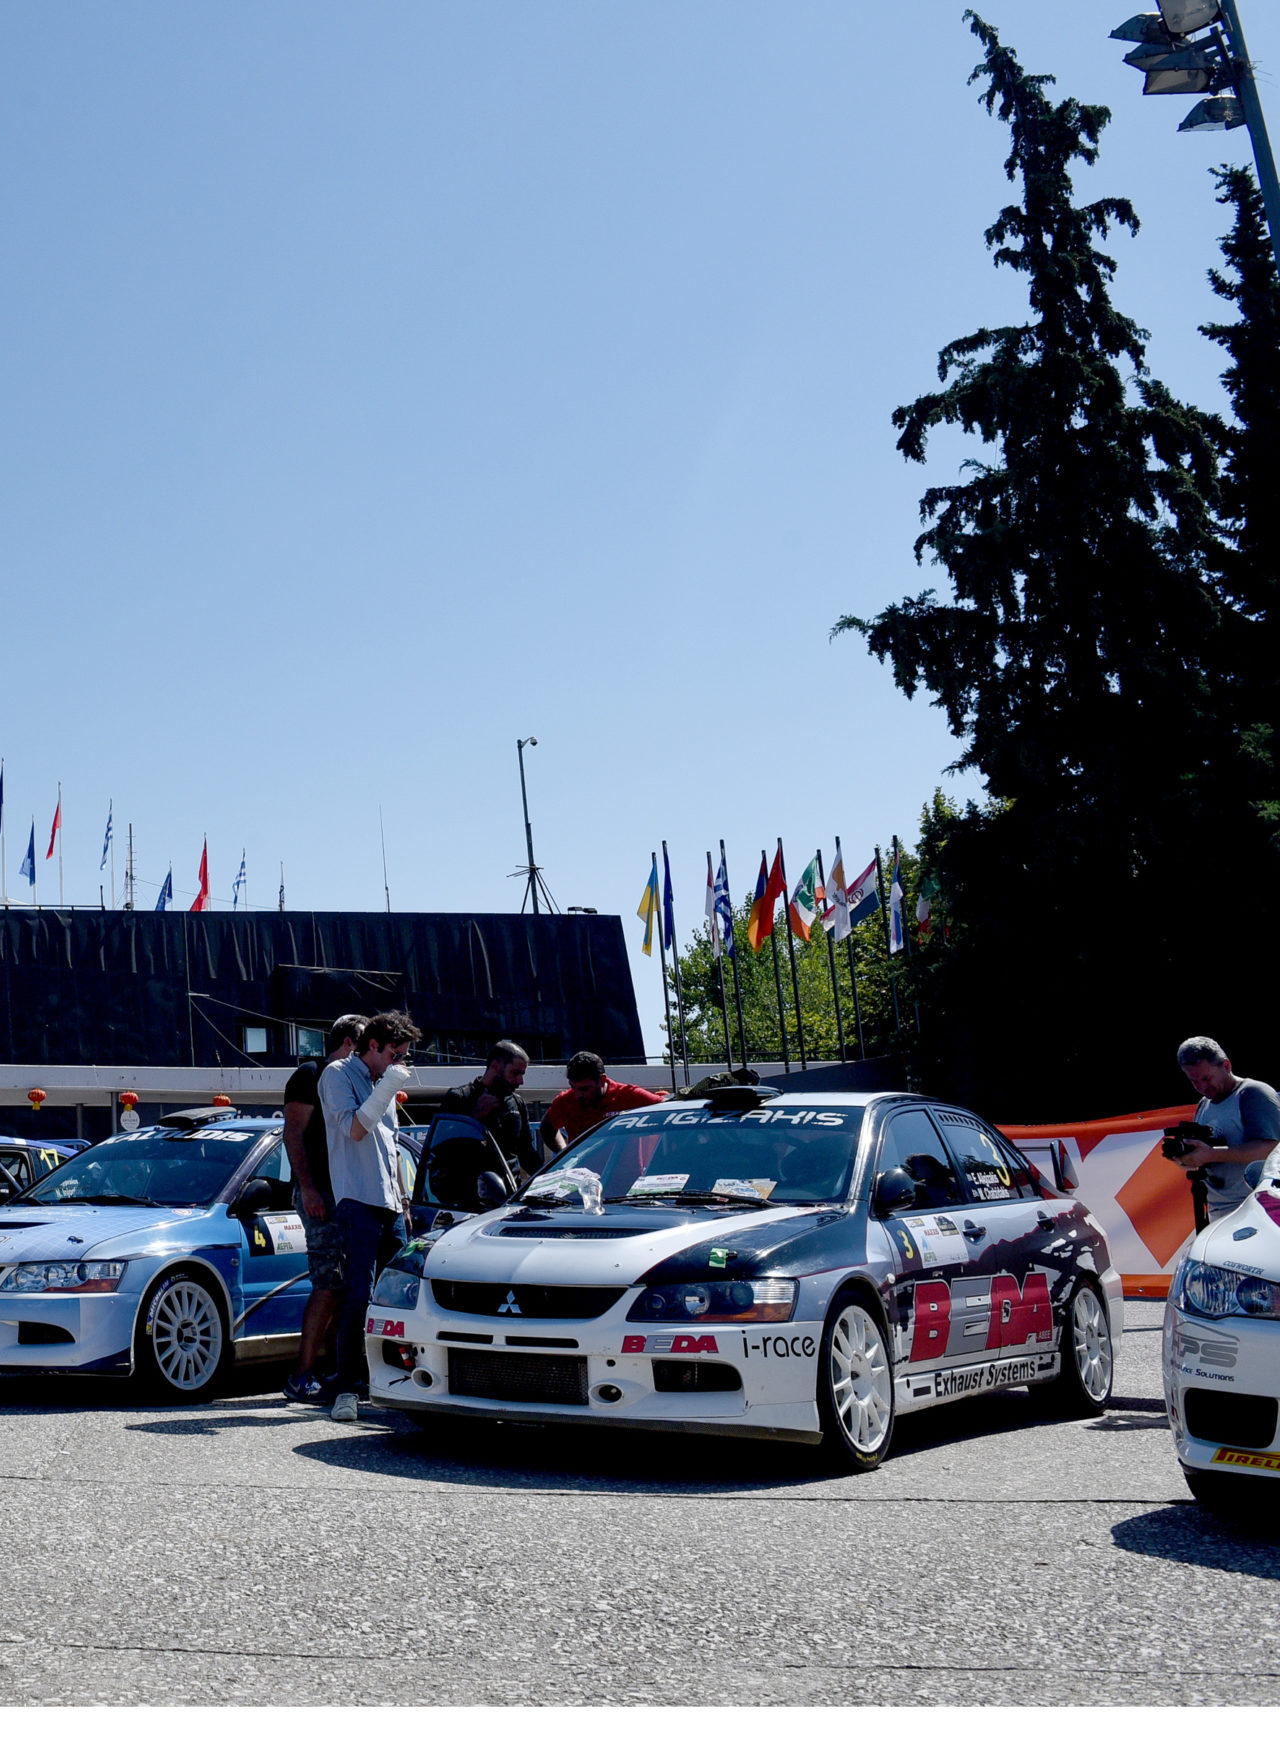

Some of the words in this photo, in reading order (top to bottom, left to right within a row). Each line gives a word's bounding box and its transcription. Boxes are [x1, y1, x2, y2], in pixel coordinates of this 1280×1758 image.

[254, 1229, 266, 1248] 4
[896, 1230, 914, 1260] 3
[621, 1335, 719, 1354] BEDA
[742, 1329, 816, 1359] i-race
[934, 1366, 984, 1398] Exhaust
[986, 1360, 1036, 1387] Systems
